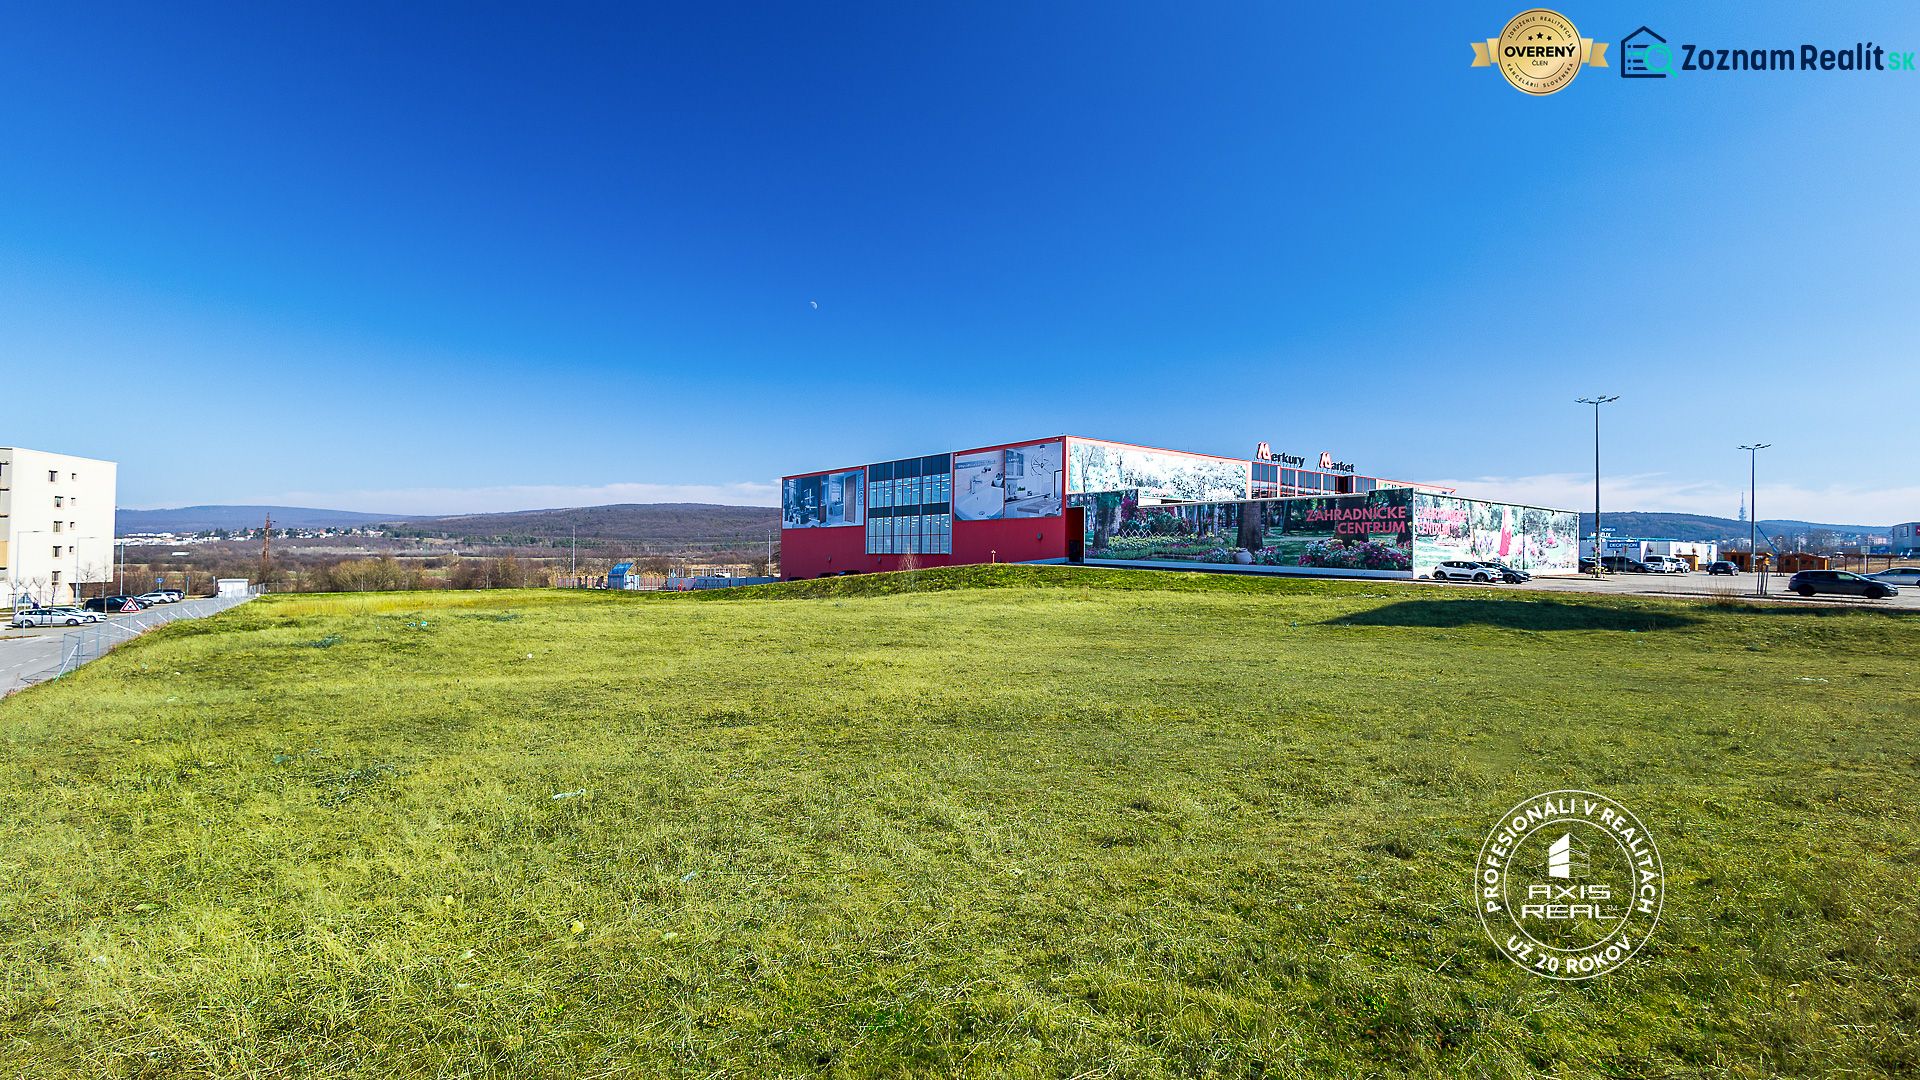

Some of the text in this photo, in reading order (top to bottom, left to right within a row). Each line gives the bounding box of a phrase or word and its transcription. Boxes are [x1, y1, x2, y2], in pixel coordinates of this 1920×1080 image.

[1256, 441, 1355, 473] Merkury Market
[1306, 502, 1406, 522] ZÁHRADNÍCKE
[1337, 520, 1406, 535] CENTRUM
